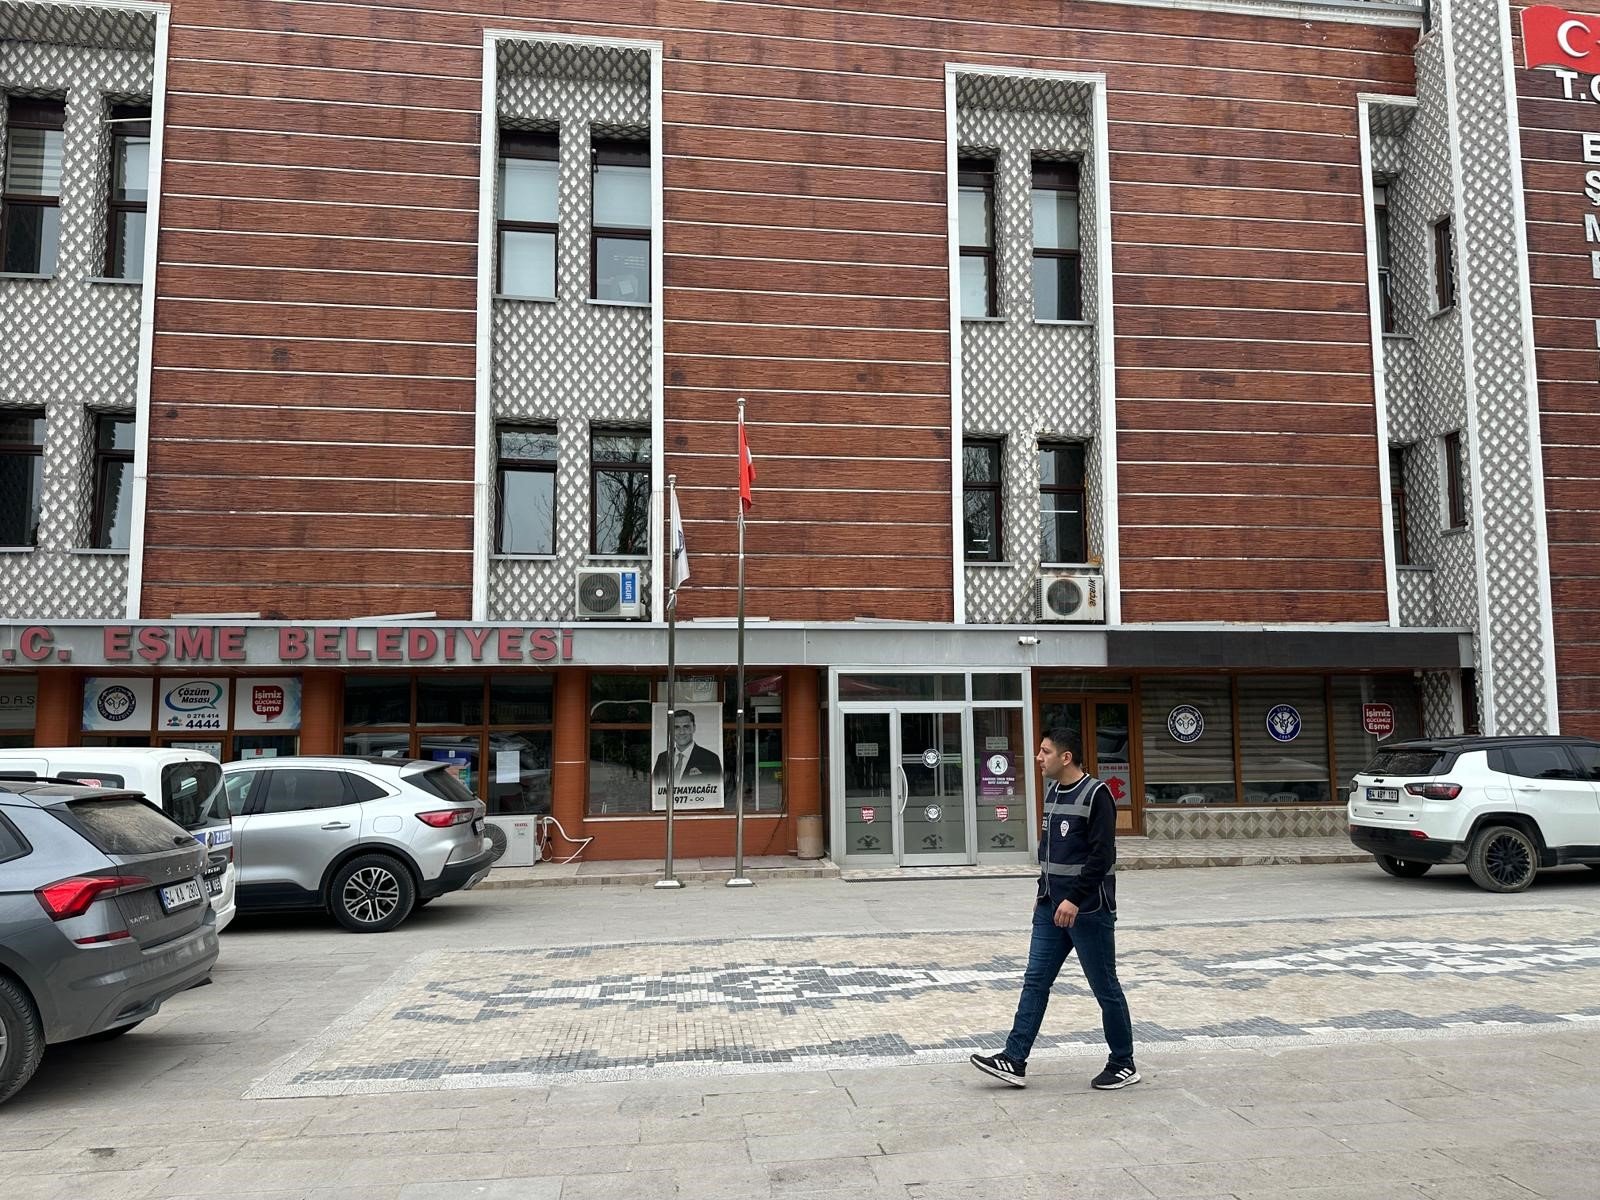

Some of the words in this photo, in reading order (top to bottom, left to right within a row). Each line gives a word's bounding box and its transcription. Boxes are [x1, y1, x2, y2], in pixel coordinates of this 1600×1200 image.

[103, 626, 249, 665] EŞME
[278, 626, 575, 662] BELEDİYESİ
[178, 687, 210, 698] Çözüm
[181, 696, 211, 704] Masası
[186, 719, 220, 729] 4444
[657, 783, 718, 796] UNTMAYACAĞIZ
